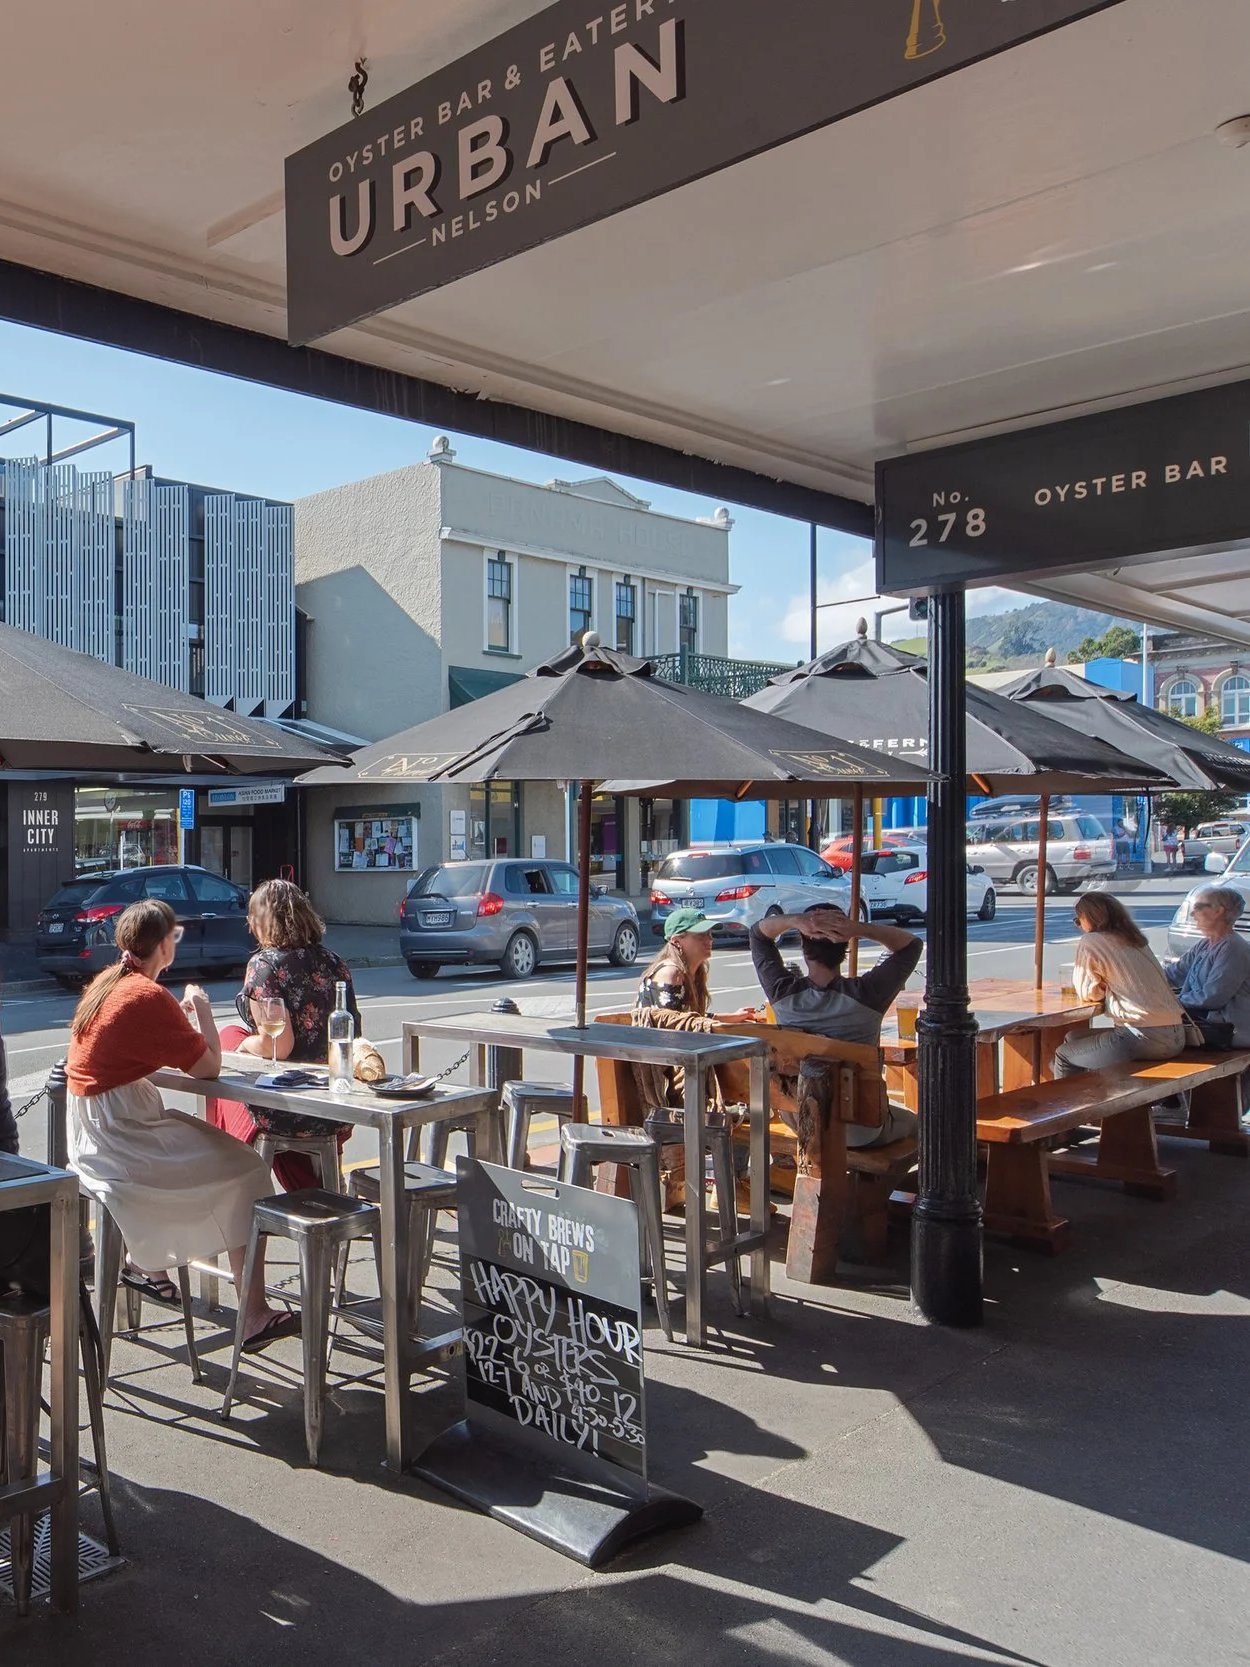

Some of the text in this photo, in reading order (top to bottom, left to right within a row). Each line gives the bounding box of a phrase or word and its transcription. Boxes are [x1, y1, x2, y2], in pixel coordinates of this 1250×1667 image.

[328, 0, 675, 182] OYSTER BAR & EATER
[329, 18, 686, 257] URBAN
[431, 179, 542, 247] NELSON
[932, 490, 970, 508] No.
[1034, 455, 1229, 506] OYSTER BAR
[908, 508, 987, 548] 278
[23, 809, 59, 826] INNER
[34, 791, 48, 802] 279
[27, 828, 55, 845] CITY
[492, 1198, 595, 1253] CRAFTY BREWS
[512, 1231, 571, 1276] ON TAP
[469, 1261, 644, 1364] HAPPY HOUR
[493, 1313, 620, 1387] OYSTERS
[521, 1374, 562, 1410] AND
[509, 1395, 599, 1458] DAILY!
